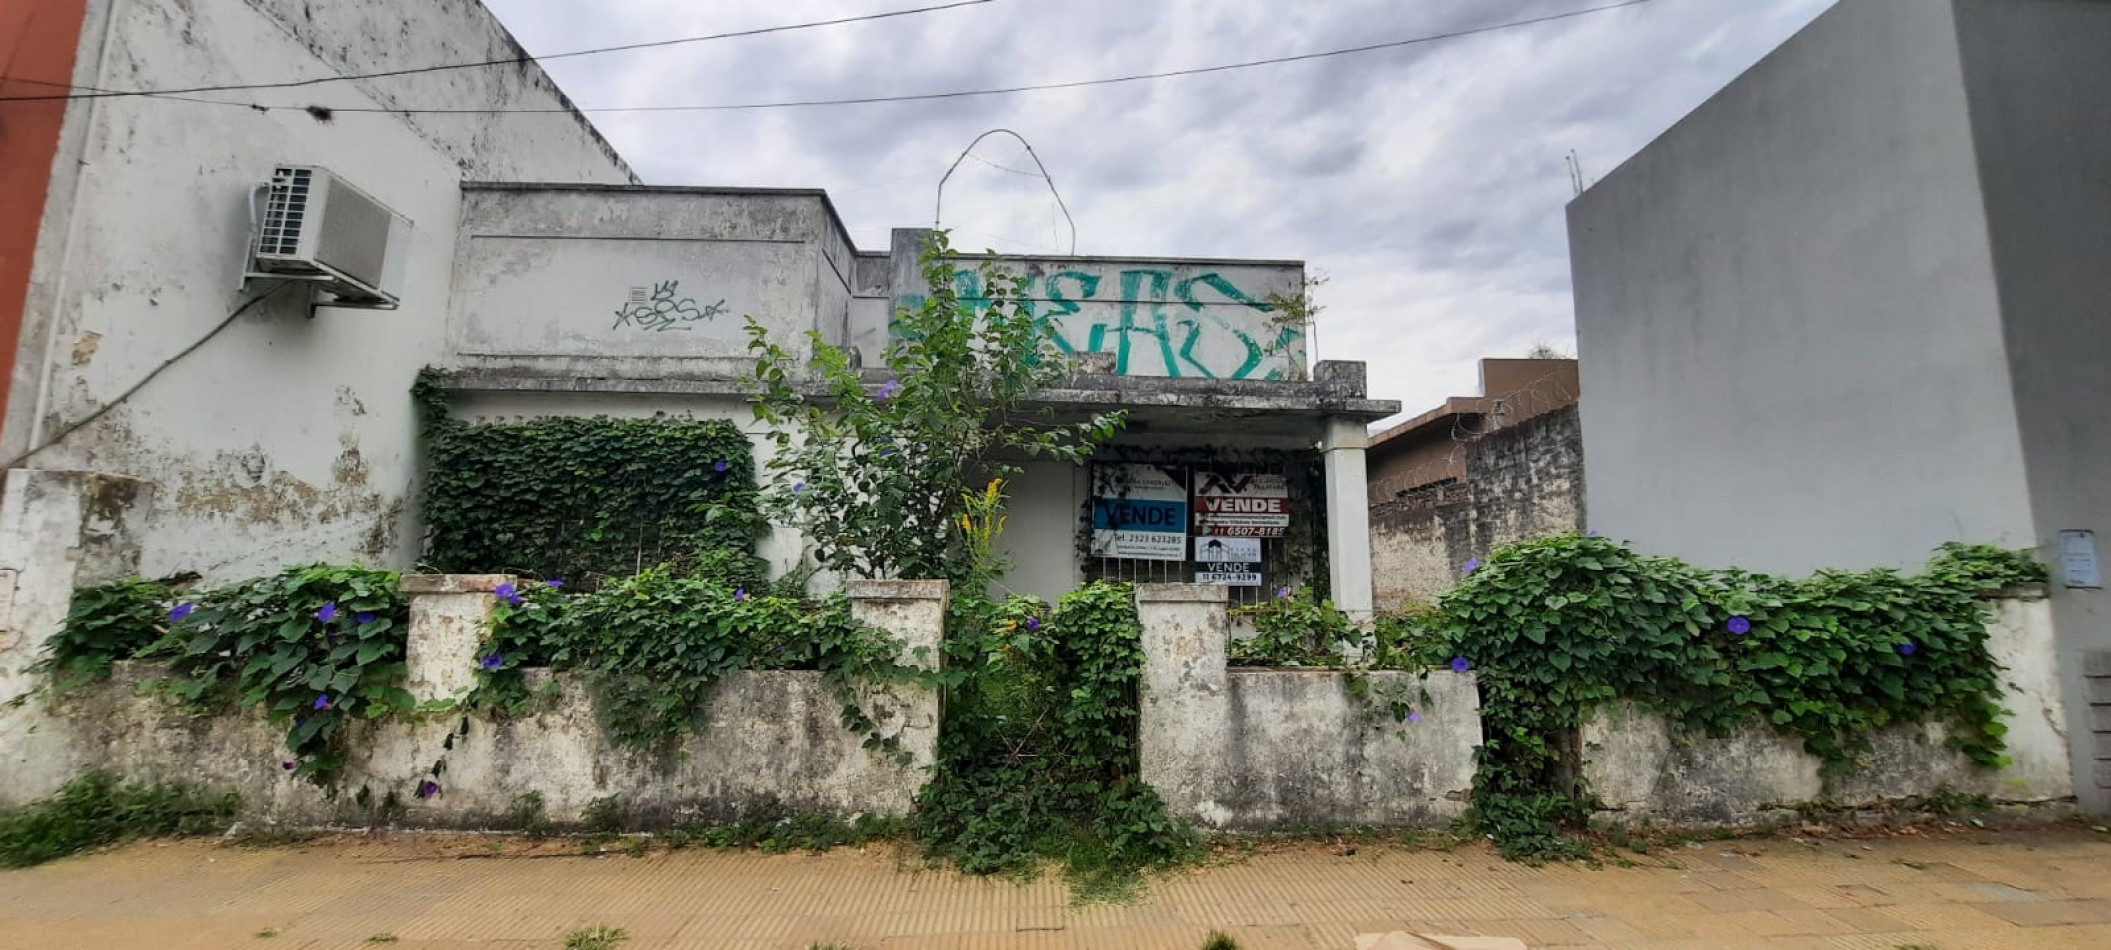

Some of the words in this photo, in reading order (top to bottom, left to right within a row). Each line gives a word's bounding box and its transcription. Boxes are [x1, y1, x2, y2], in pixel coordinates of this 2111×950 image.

[1205, 498, 1282, 513] VENDE
[1103, 503, 1177, 526] VENDE
[1129, 533, 1149, 542] 2323
[1207, 562, 1252, 573] VENDE
